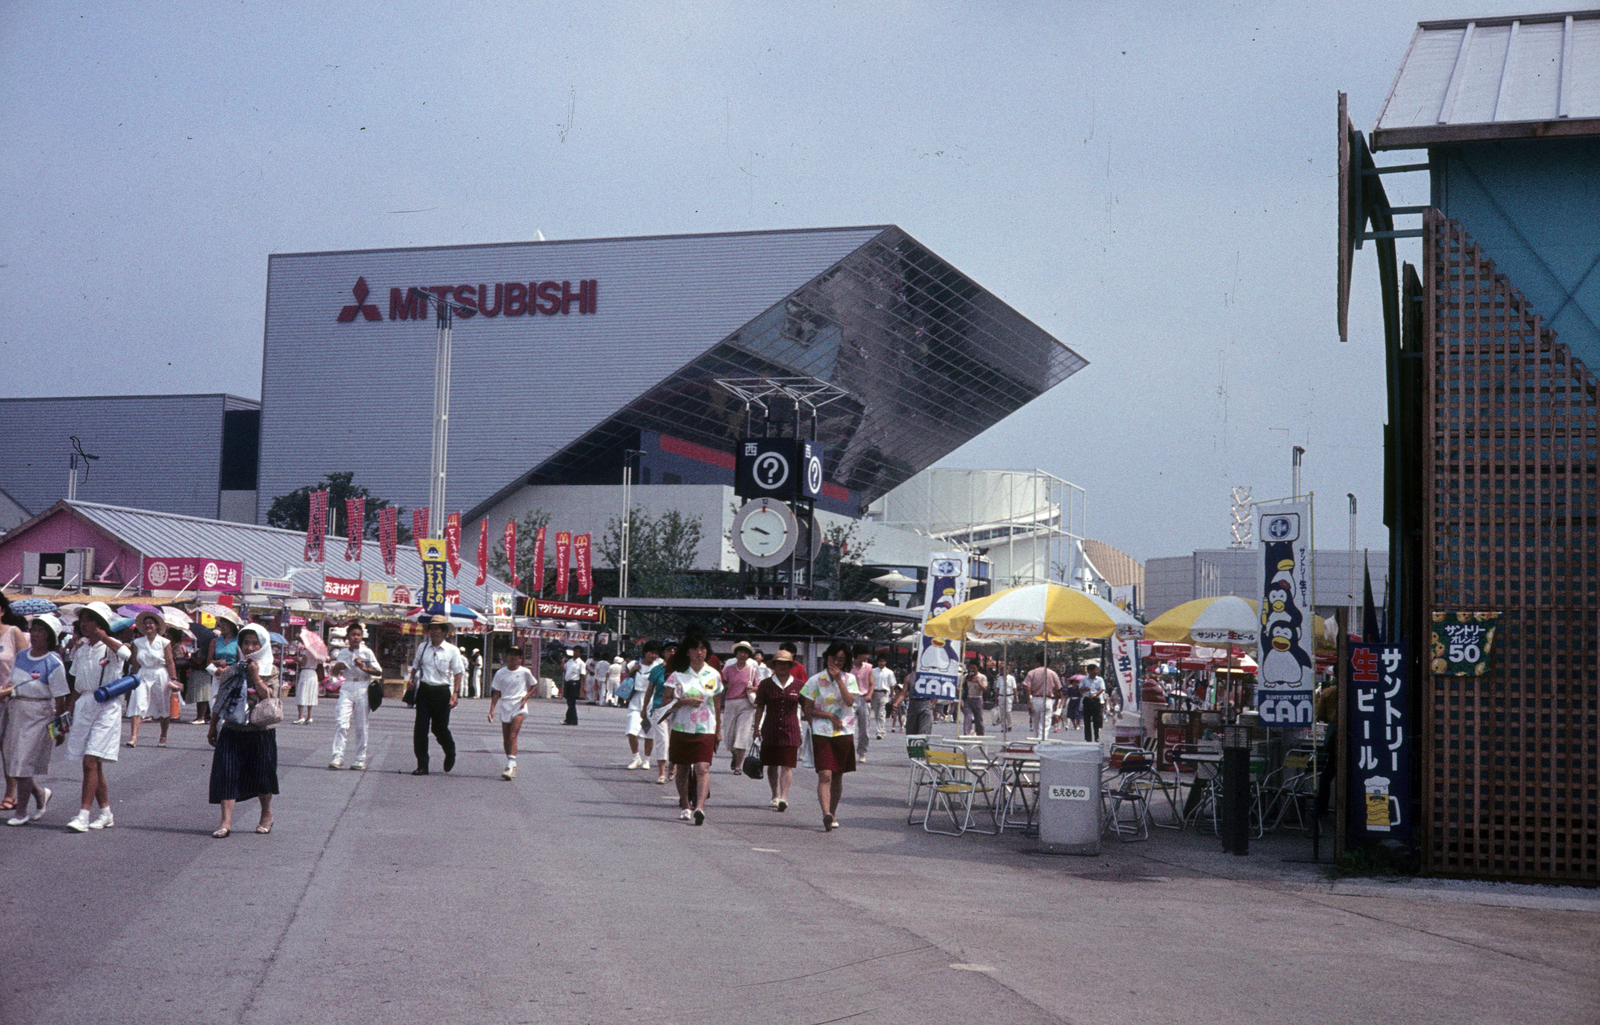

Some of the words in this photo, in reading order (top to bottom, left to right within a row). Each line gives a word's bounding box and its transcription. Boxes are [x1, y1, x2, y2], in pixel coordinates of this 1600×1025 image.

[389, 280, 598, 320] MITSUBISHI
[744, 442, 758, 456] 西
[168, 564, 196, 582] 三越
[217, 568, 237, 587] 三越
[324, 581, 360, 596] おみやげ
[538, 603, 568, 615] マクドナルド
[568, 606, 598, 617] ハンバーガー
[983, 621, 1038, 632] サントリーエード
[1444, 625, 1486, 636] サントリー
[1197, 630, 1256, 641] サントリー生ビール
[1450, 635, 1480, 645] オレンジ
[1449, 644, 1481, 663] 50
[1259, 699, 1313, 722] CAN
[1351, 648, 1379, 770] 生ビール
[1381, 648, 1403, 771] サントリー
[1052, 788, 1086, 798] もえるもの
